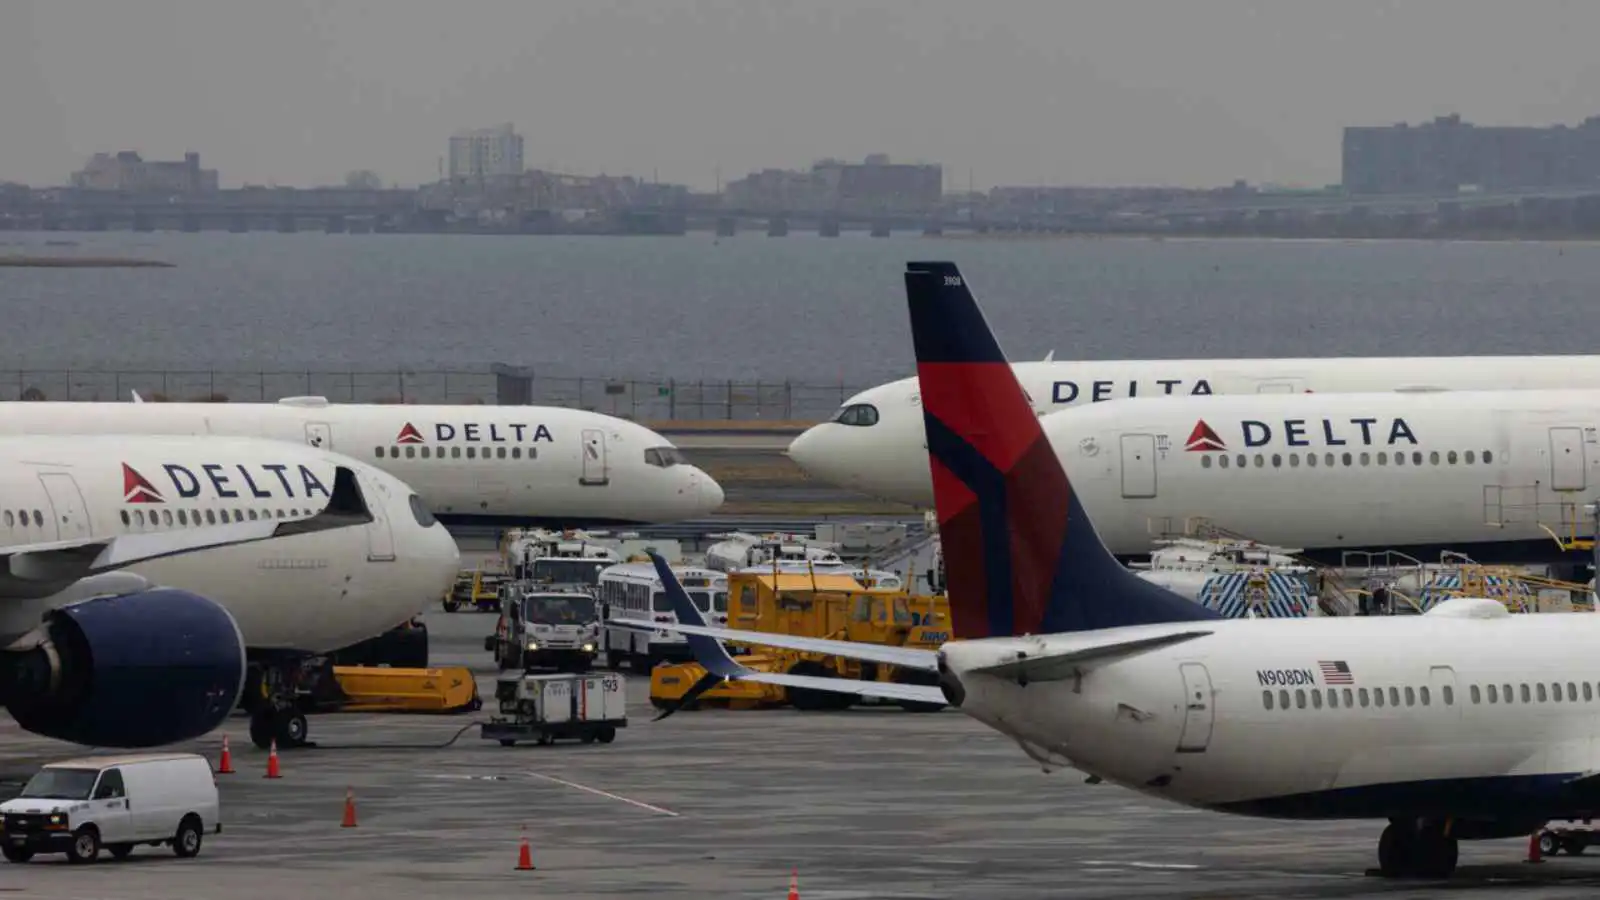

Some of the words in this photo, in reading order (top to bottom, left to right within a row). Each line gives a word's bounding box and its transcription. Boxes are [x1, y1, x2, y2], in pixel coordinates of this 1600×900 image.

[435, 424, 554, 443] DELTA
[1241, 418, 1419, 447] DELTA
[163, 464, 330, 499] DELTA
[1256, 670, 1316, 686] N908DN
